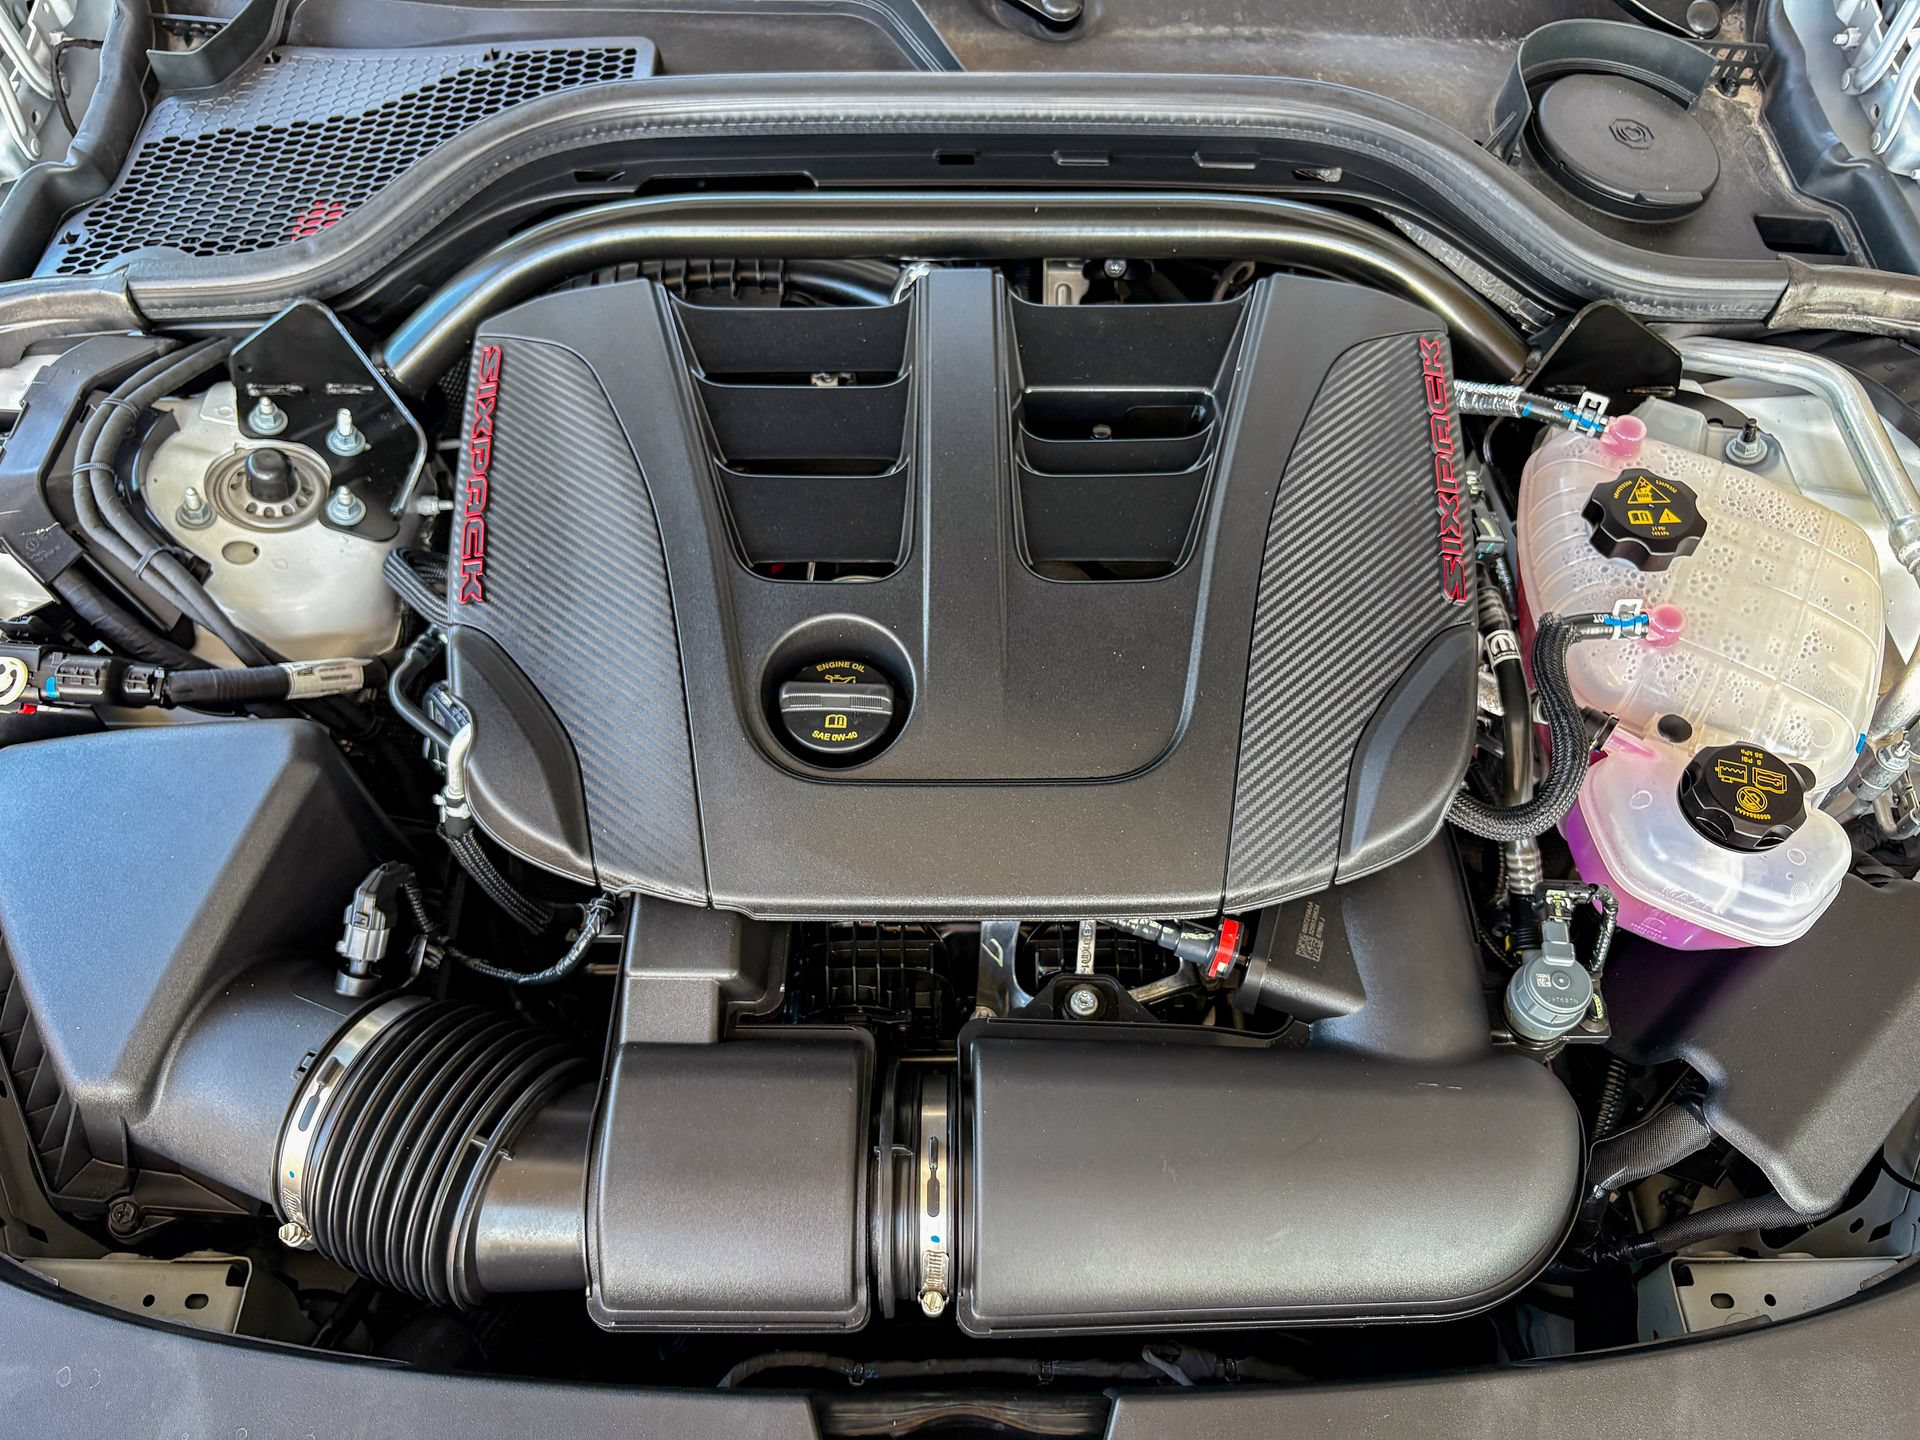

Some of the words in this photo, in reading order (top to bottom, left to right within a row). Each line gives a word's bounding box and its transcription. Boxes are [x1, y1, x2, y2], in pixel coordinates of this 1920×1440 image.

[459, 344, 503, 605] SIXPACK
[1419, 338, 1468, 605] SIXPACK
[816, 661, 850, 672] ENGINE
[851, 663, 865, 673] OIL
[811, 730, 831, 741] SAE
[831, 731, 858, 742] 0W-40
[1741, 756, 1753, 764] PSI
